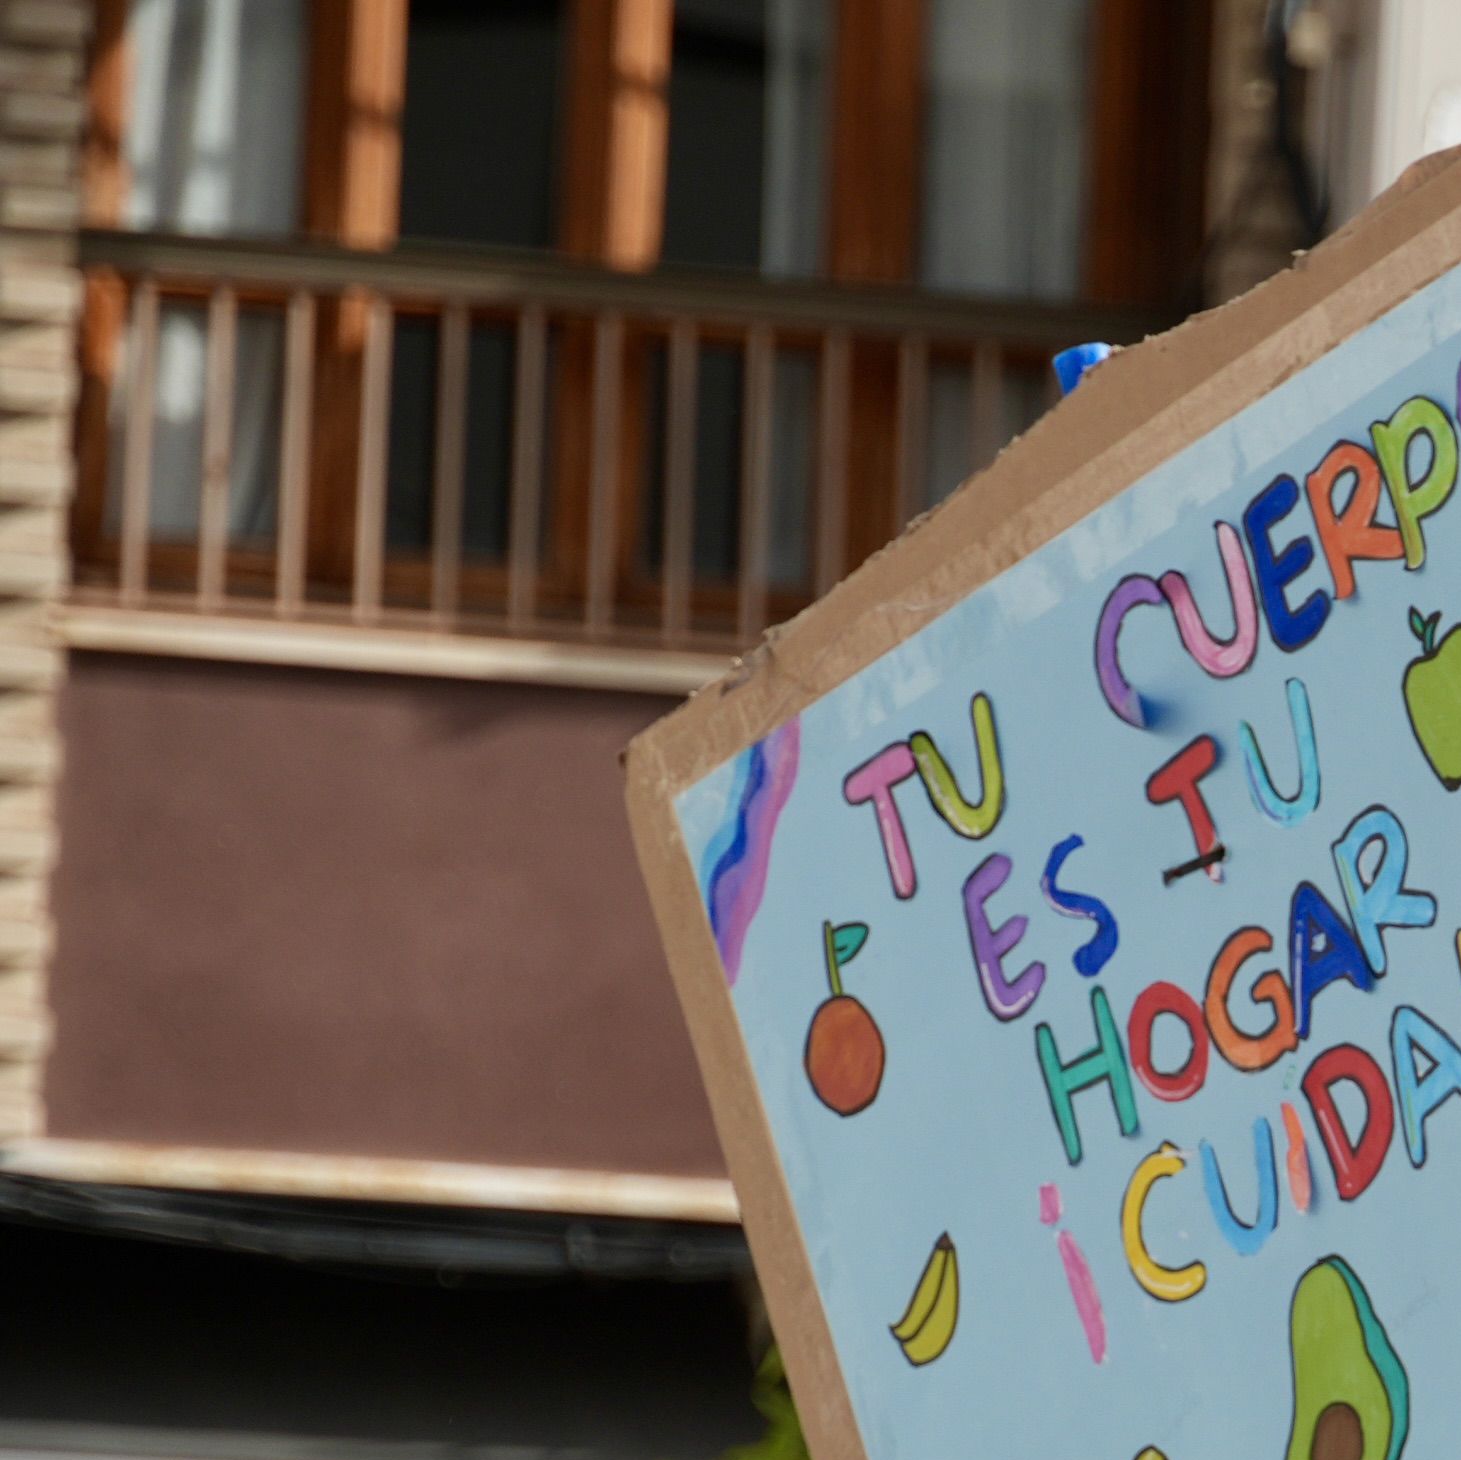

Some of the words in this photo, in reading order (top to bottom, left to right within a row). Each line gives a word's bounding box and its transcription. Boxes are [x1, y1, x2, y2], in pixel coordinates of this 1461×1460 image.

[844, 693, 1006, 899] TU
[962, 834, 1118, 1021] ES
[1146, 678, 1322, 882] TU
[1035, 805, 1438, 1166] HOGAR
